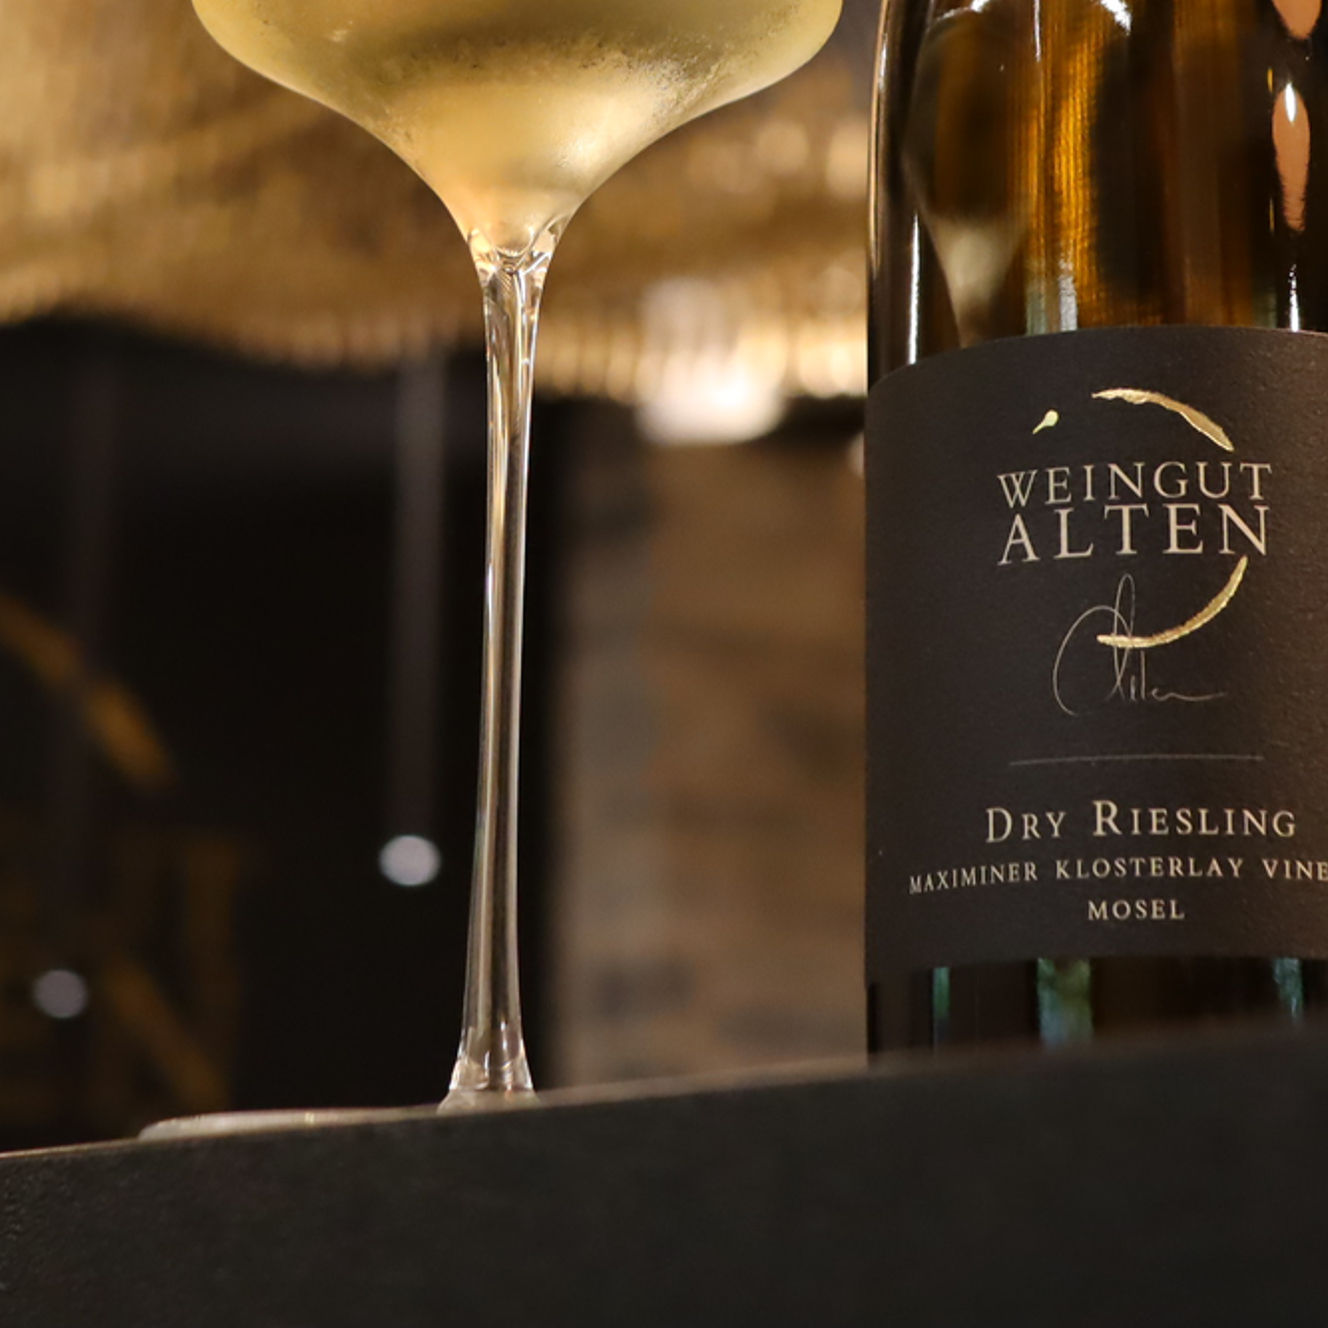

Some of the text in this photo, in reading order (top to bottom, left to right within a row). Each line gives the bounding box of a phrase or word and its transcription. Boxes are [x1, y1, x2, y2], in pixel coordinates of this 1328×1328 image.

[998, 461, 1273, 508] WEINGUT
[998, 502, 1269, 565] ALTEN
[909, 860, 1038, 895] MAXIMINER
[1055, 855, 1244, 881] KLOSTERLAY
[1087, 899, 1186, 921] MOSEL
